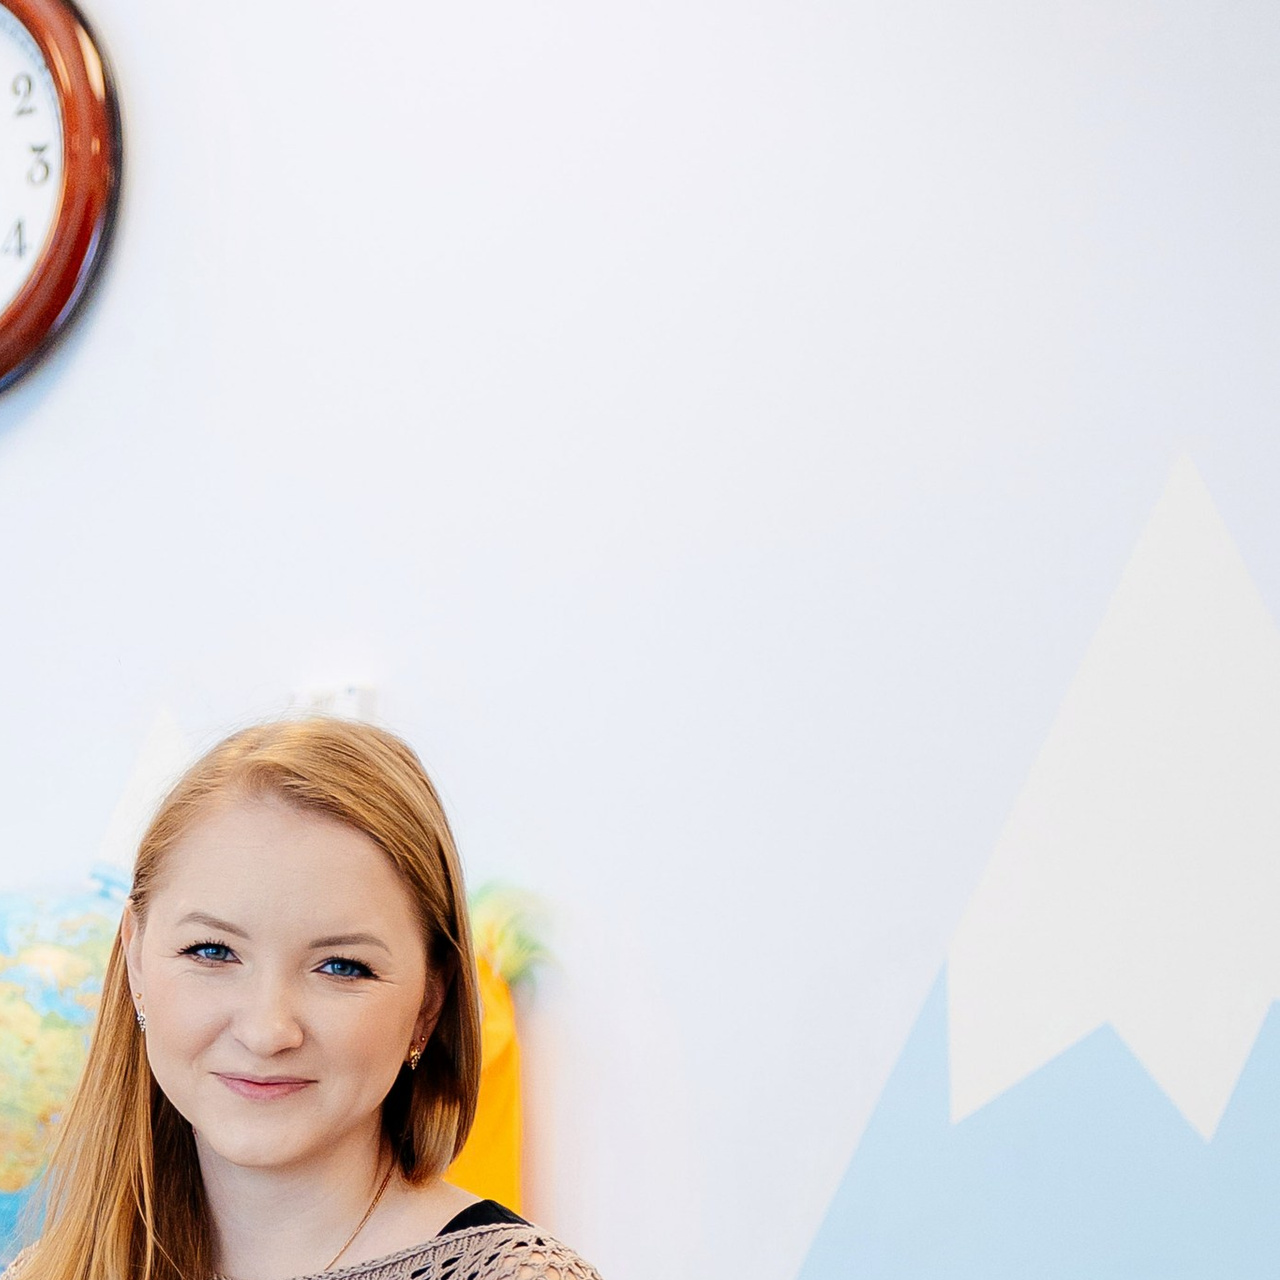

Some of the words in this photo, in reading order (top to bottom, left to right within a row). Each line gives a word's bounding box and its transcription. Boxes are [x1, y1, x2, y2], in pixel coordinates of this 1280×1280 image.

[11, 73, 36, 115] 2
[27, 144, 50, 185] 3
[1, 220, 31, 259] 4
